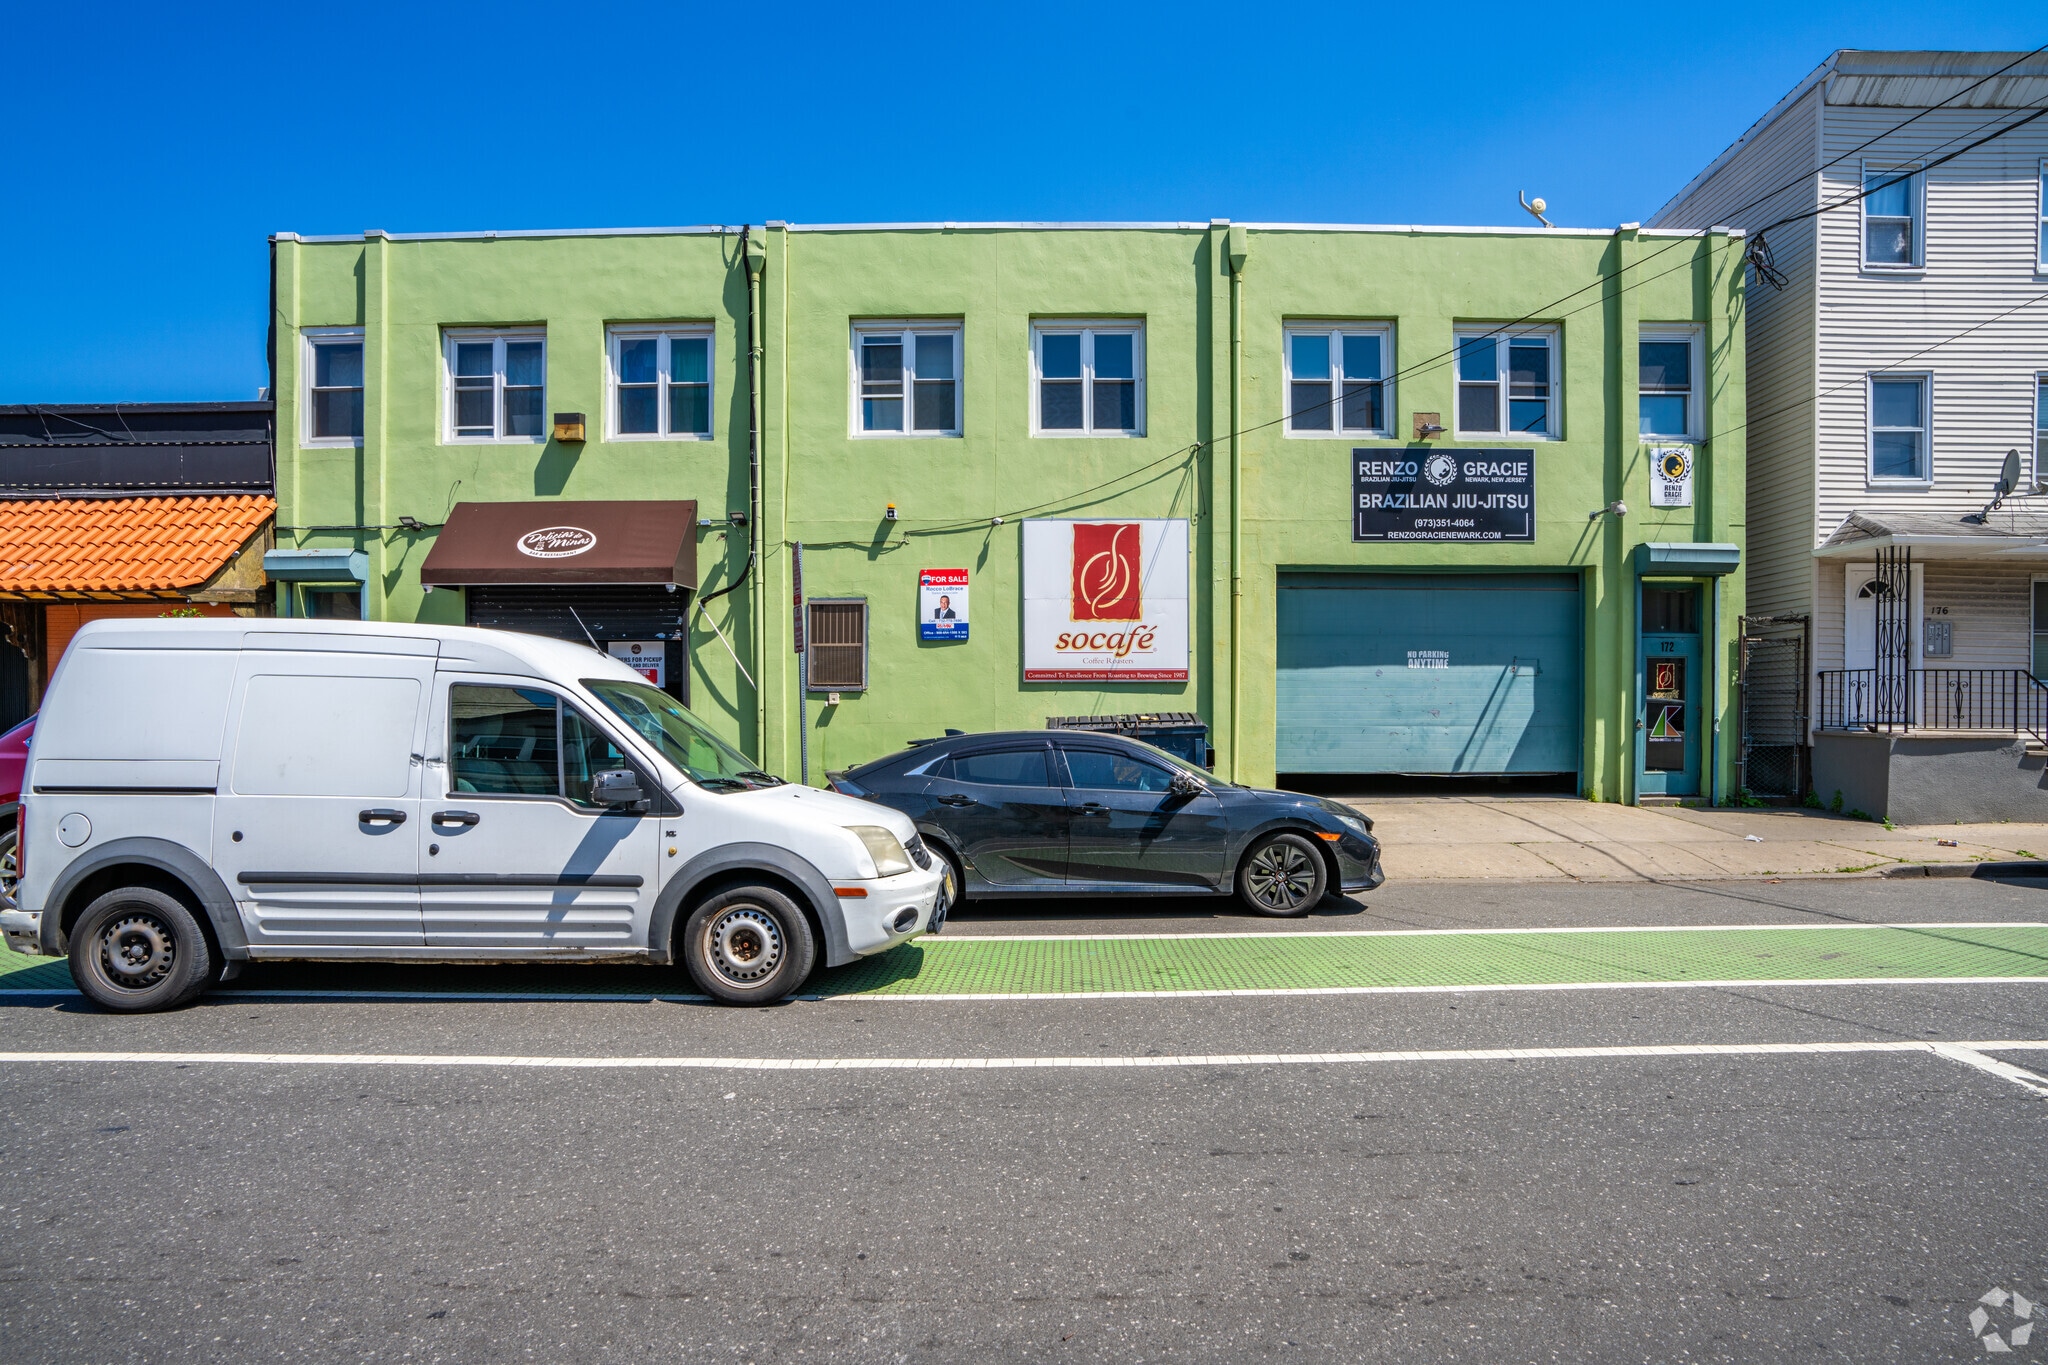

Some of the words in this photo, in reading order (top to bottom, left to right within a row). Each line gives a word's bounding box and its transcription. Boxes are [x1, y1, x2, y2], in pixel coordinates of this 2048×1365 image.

[1359, 462, 1418, 476] RENZO
[1463, 462, 1528, 476] GRACIE
[1359, 494, 1447, 508] BRAZILIAN
[1452, 494, 1528, 509] JIU-JITSU
[1415, 519, 1474, 528] (973)351-4064
[548, 538, 590, 548] Minas
[1931, 606, 1949, 615] 176
[1055, 625, 1158, 658] socafé
[1661, 642, 1674, 652] 172
[1408, 659, 1448, 669] ANYTIME
